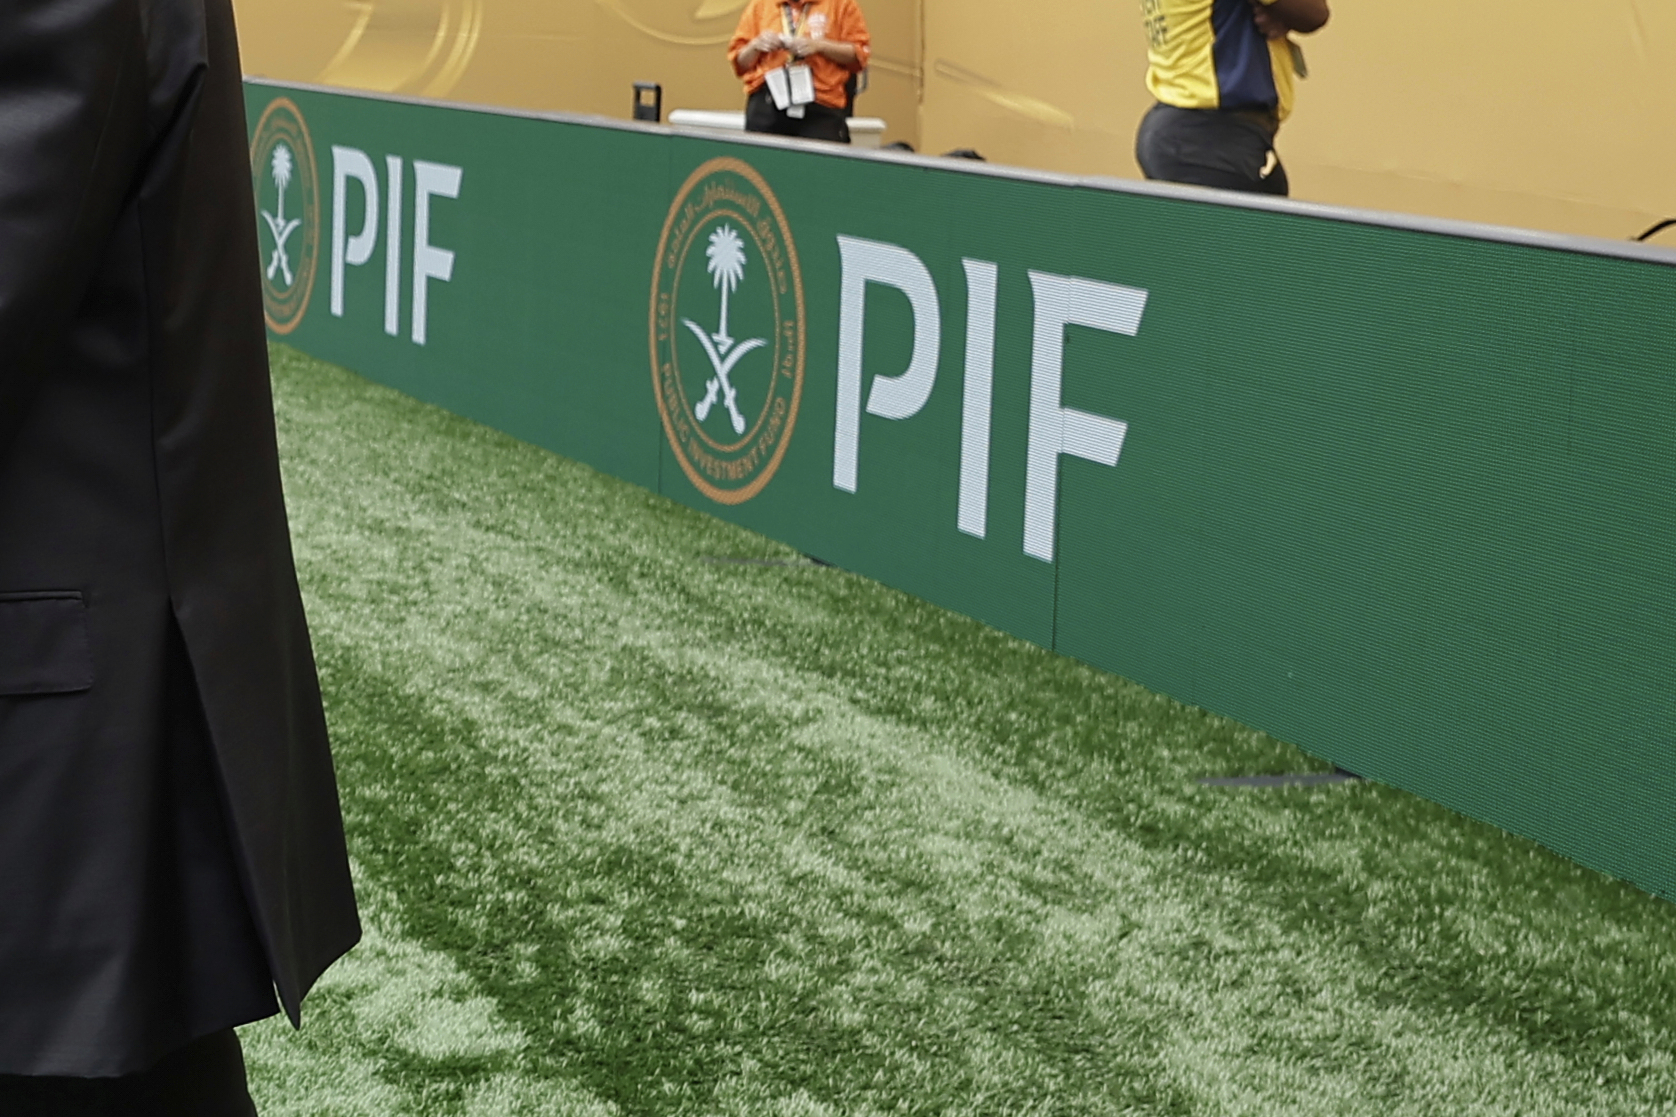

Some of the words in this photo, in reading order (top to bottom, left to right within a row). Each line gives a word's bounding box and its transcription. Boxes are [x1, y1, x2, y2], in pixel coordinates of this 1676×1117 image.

[330, 144, 463, 346] PIF
[661, 362, 690, 443] PUBLIC
[833, 233, 1149, 564] PIF
